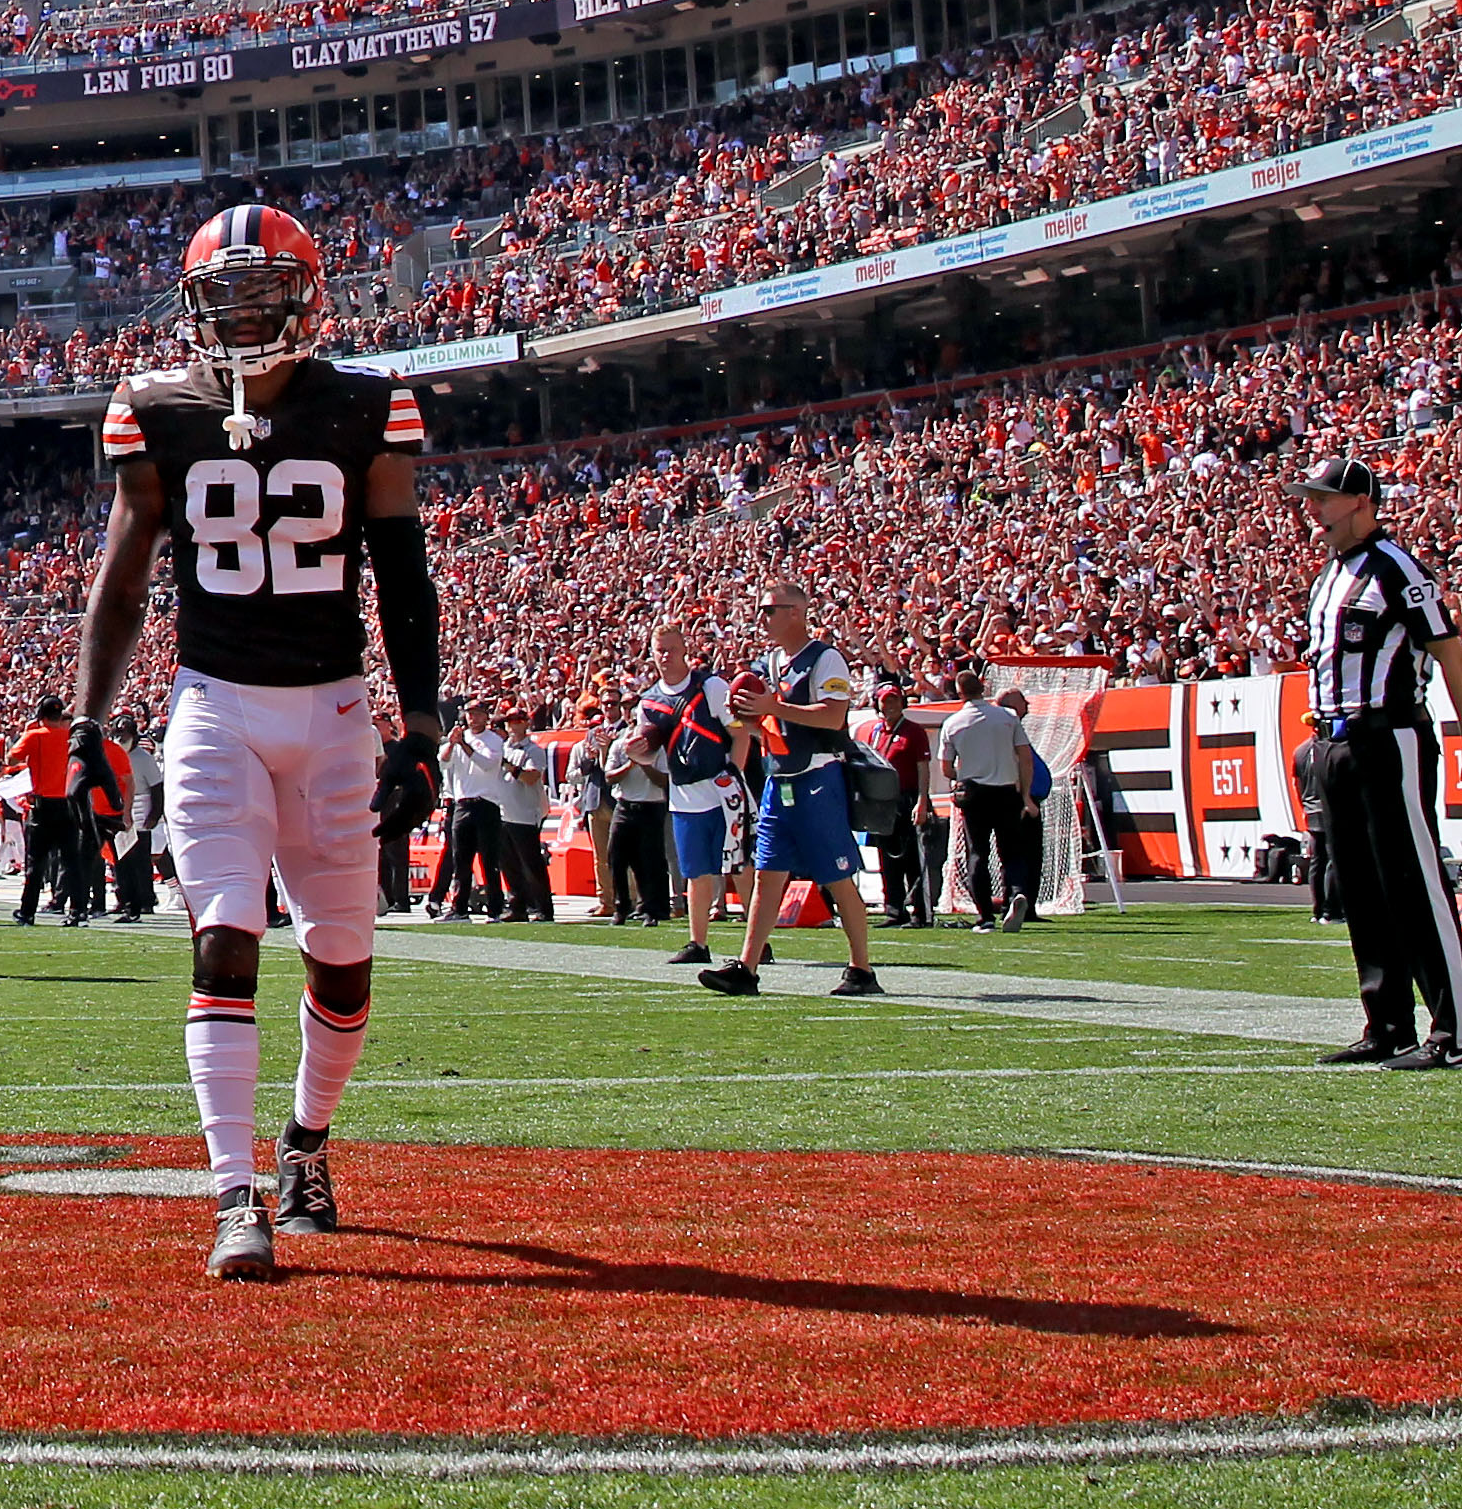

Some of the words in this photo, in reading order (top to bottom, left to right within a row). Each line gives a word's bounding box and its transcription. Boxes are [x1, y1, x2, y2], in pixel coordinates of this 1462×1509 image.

[292, 40, 347, 69] CLAY
[346, 19, 462, 63] MATTHEWS
[468, 11, 497, 42] 57
[83, 69, 129, 95] LEN
[140, 60, 198, 89] FORD
[203, 53, 234, 82] 80
[1251, 158, 1301, 189] meijer
[1043, 209, 1089, 239] meijer
[855, 256, 897, 284] meijer
[416, 341, 504, 366] MEDLIMINAL
[185, 459, 345, 595] 82
[1407, 582, 1436, 604] 87
[1212, 758, 1249, 796] EST.
